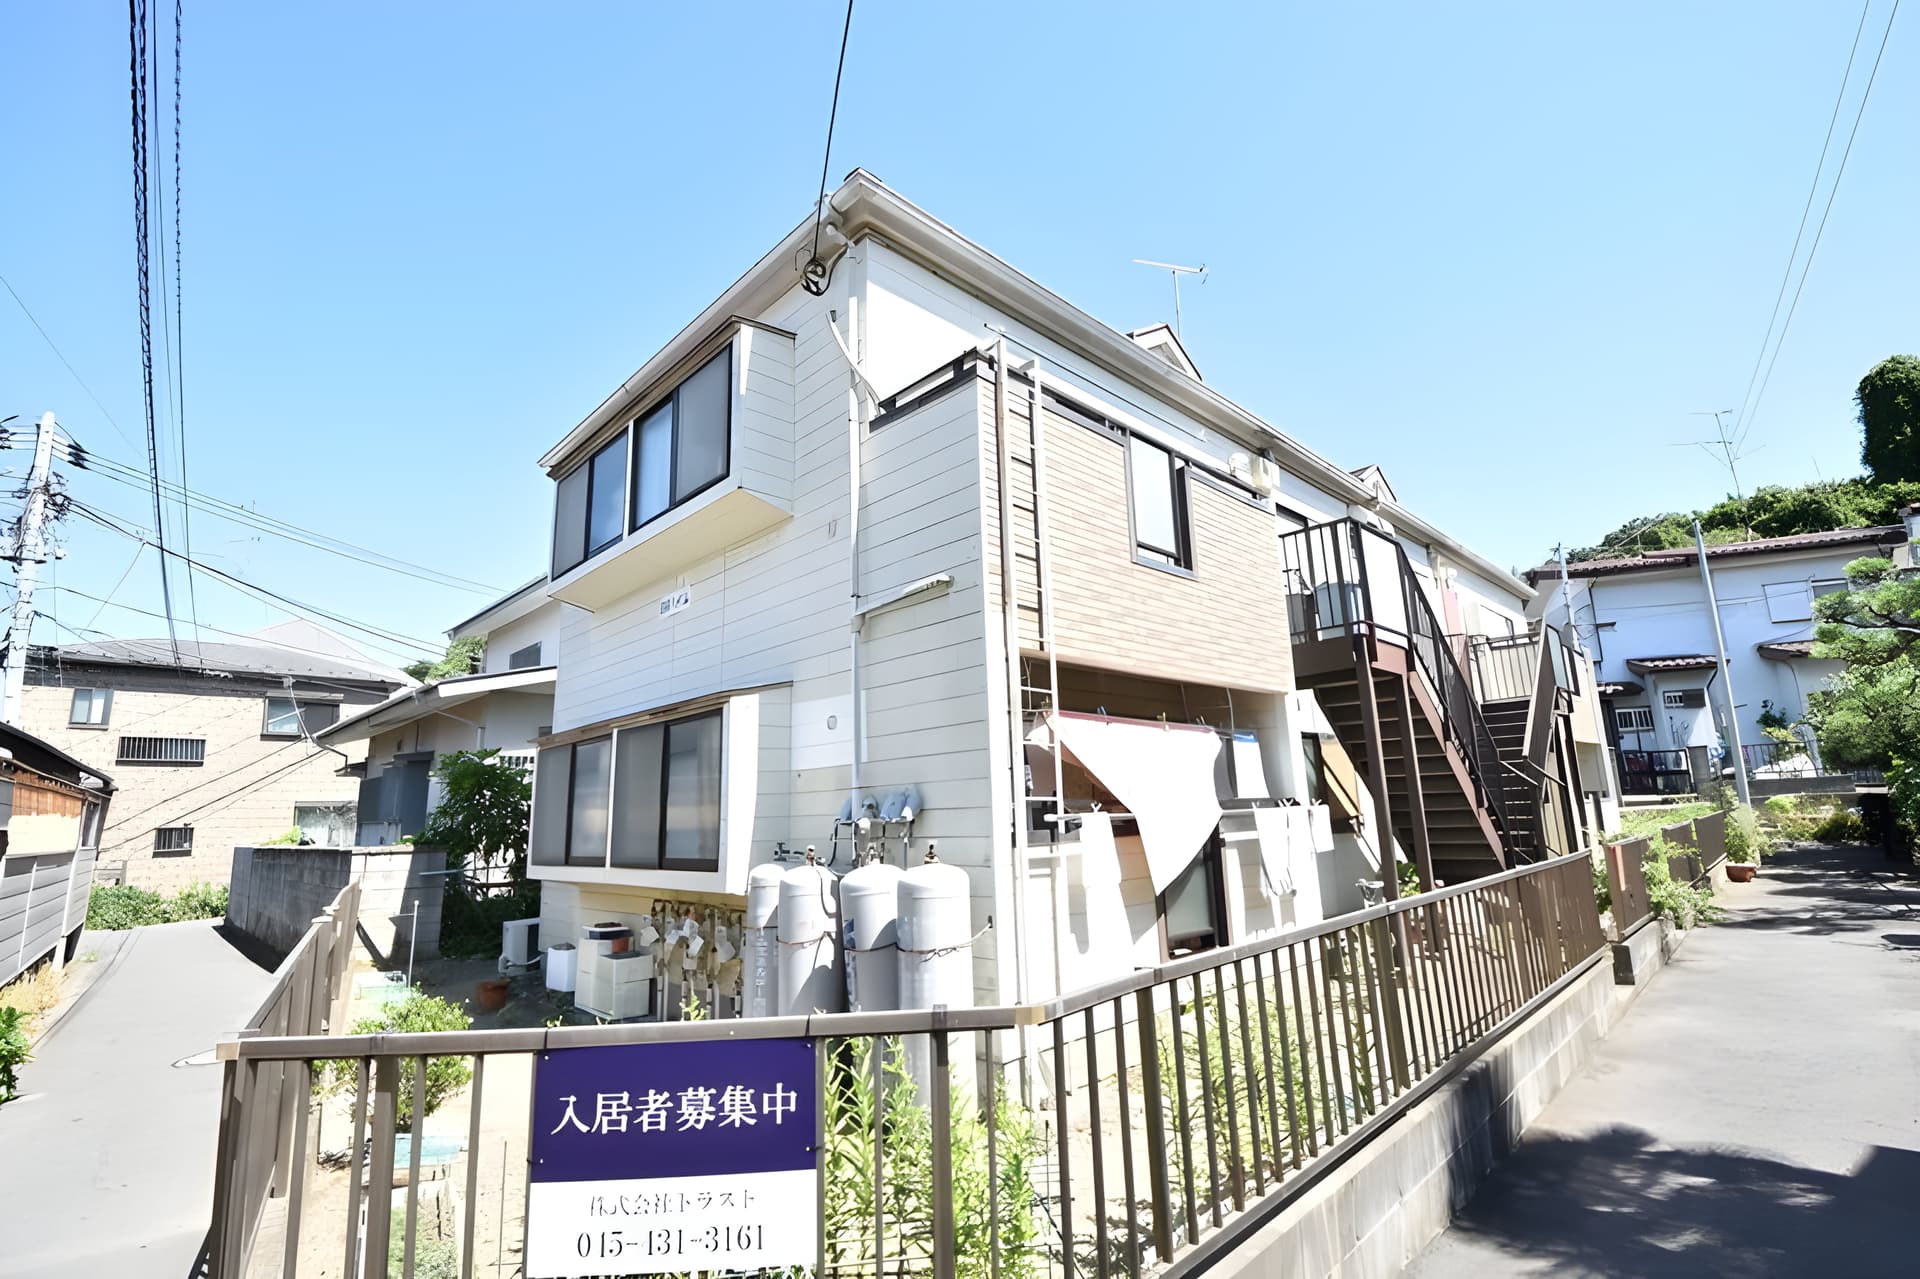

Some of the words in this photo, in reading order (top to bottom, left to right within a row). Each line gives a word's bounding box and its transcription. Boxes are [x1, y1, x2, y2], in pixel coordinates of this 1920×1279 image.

[550, 1082, 798, 1135] 入居者募集中
